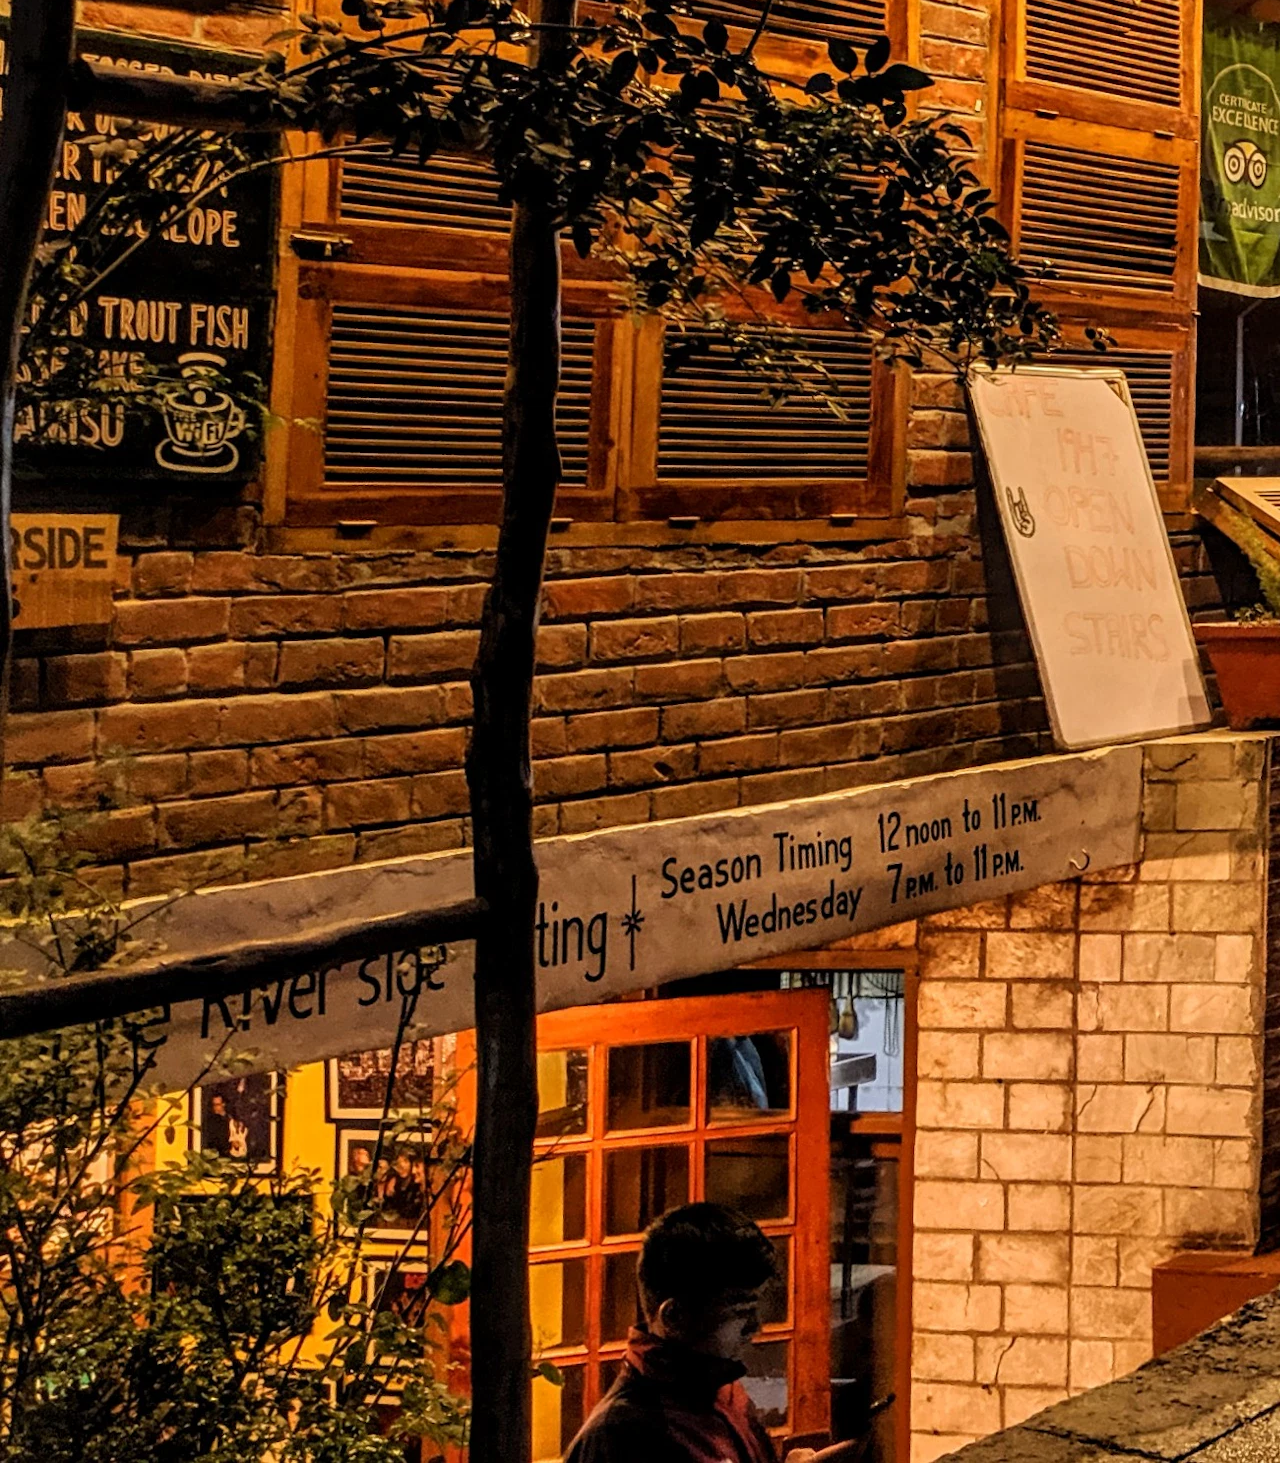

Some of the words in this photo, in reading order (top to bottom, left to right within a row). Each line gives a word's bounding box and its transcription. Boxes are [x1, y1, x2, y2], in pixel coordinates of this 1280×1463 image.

[1212, 106, 1280, 136] EXCELLENCE
[98, 296, 182, 344] TROUT
[190, 303, 248, 349] FISH
[1044, 485, 1136, 536] OPEN
[1062, 543, 1158, 592] DOWN
[1063, 610, 1172, 663] STAIRS
[661, 854, 762, 899] Season
[773, 831, 852, 873] Timing
[878, 811, 902, 854] 12
[906, 817, 953, 848] noon
[962, 798, 982, 833] to
[716, 878, 864, 945] Wednesday
[887, 862, 903, 904] 7
[944, 852, 964, 886] to
